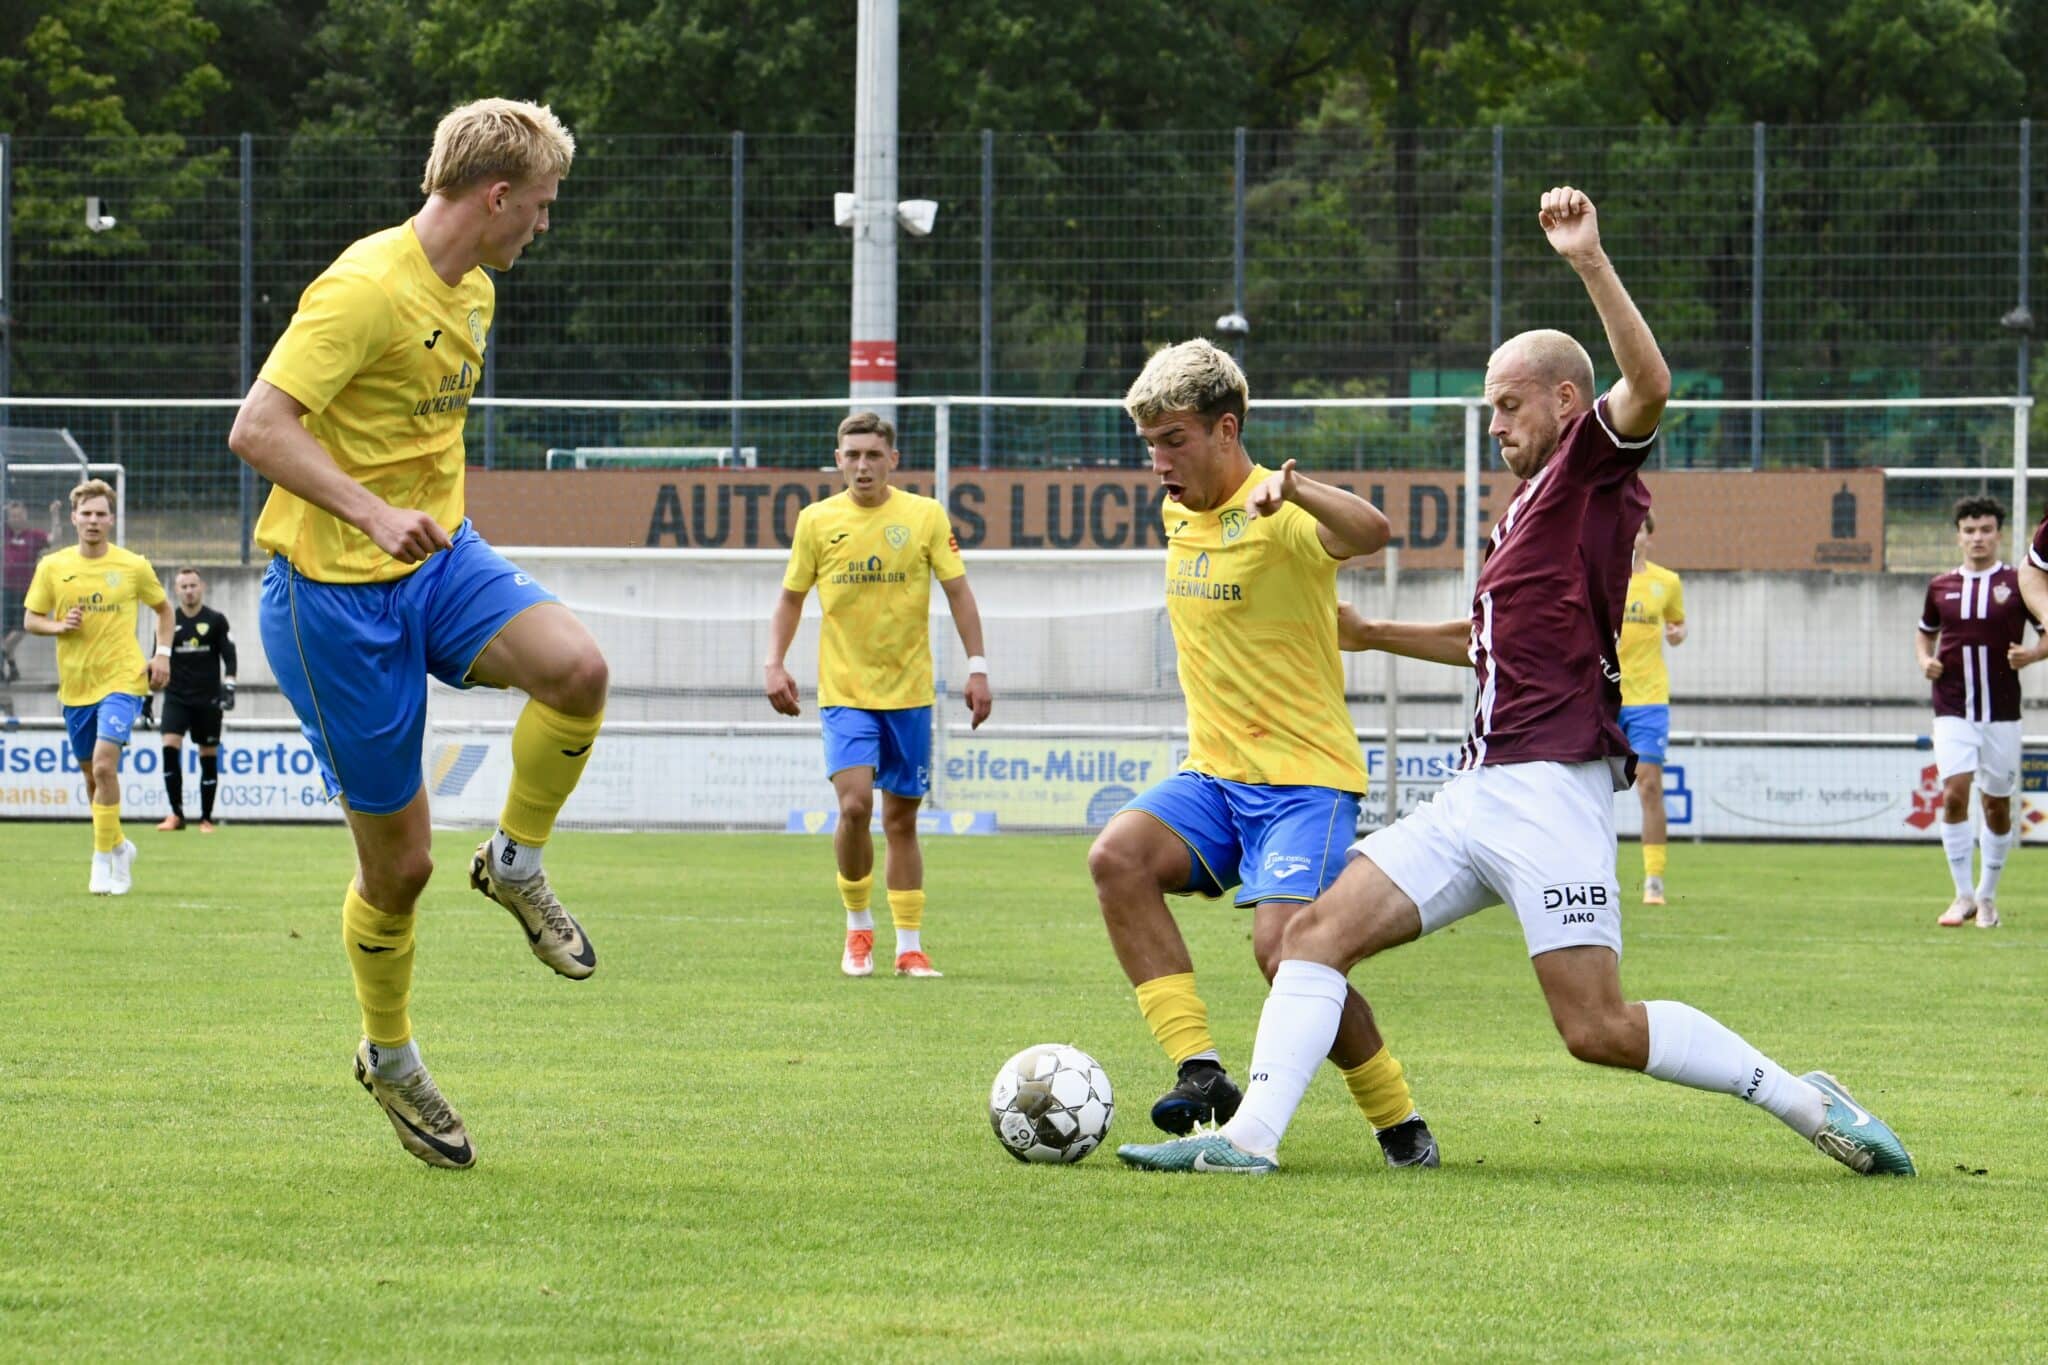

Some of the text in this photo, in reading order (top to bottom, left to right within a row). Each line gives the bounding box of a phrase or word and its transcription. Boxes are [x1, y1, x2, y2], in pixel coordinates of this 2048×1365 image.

[848, 561, 865, 572] DIE
[1178, 559, 1193, 577] DIE
[832, 572, 906, 585] LUCKENWALDER
[945, 749, 1152, 782] eifen-Müller
[1544, 885, 1608, 909] DWB
[1562, 912, 1595, 925] JAKO
